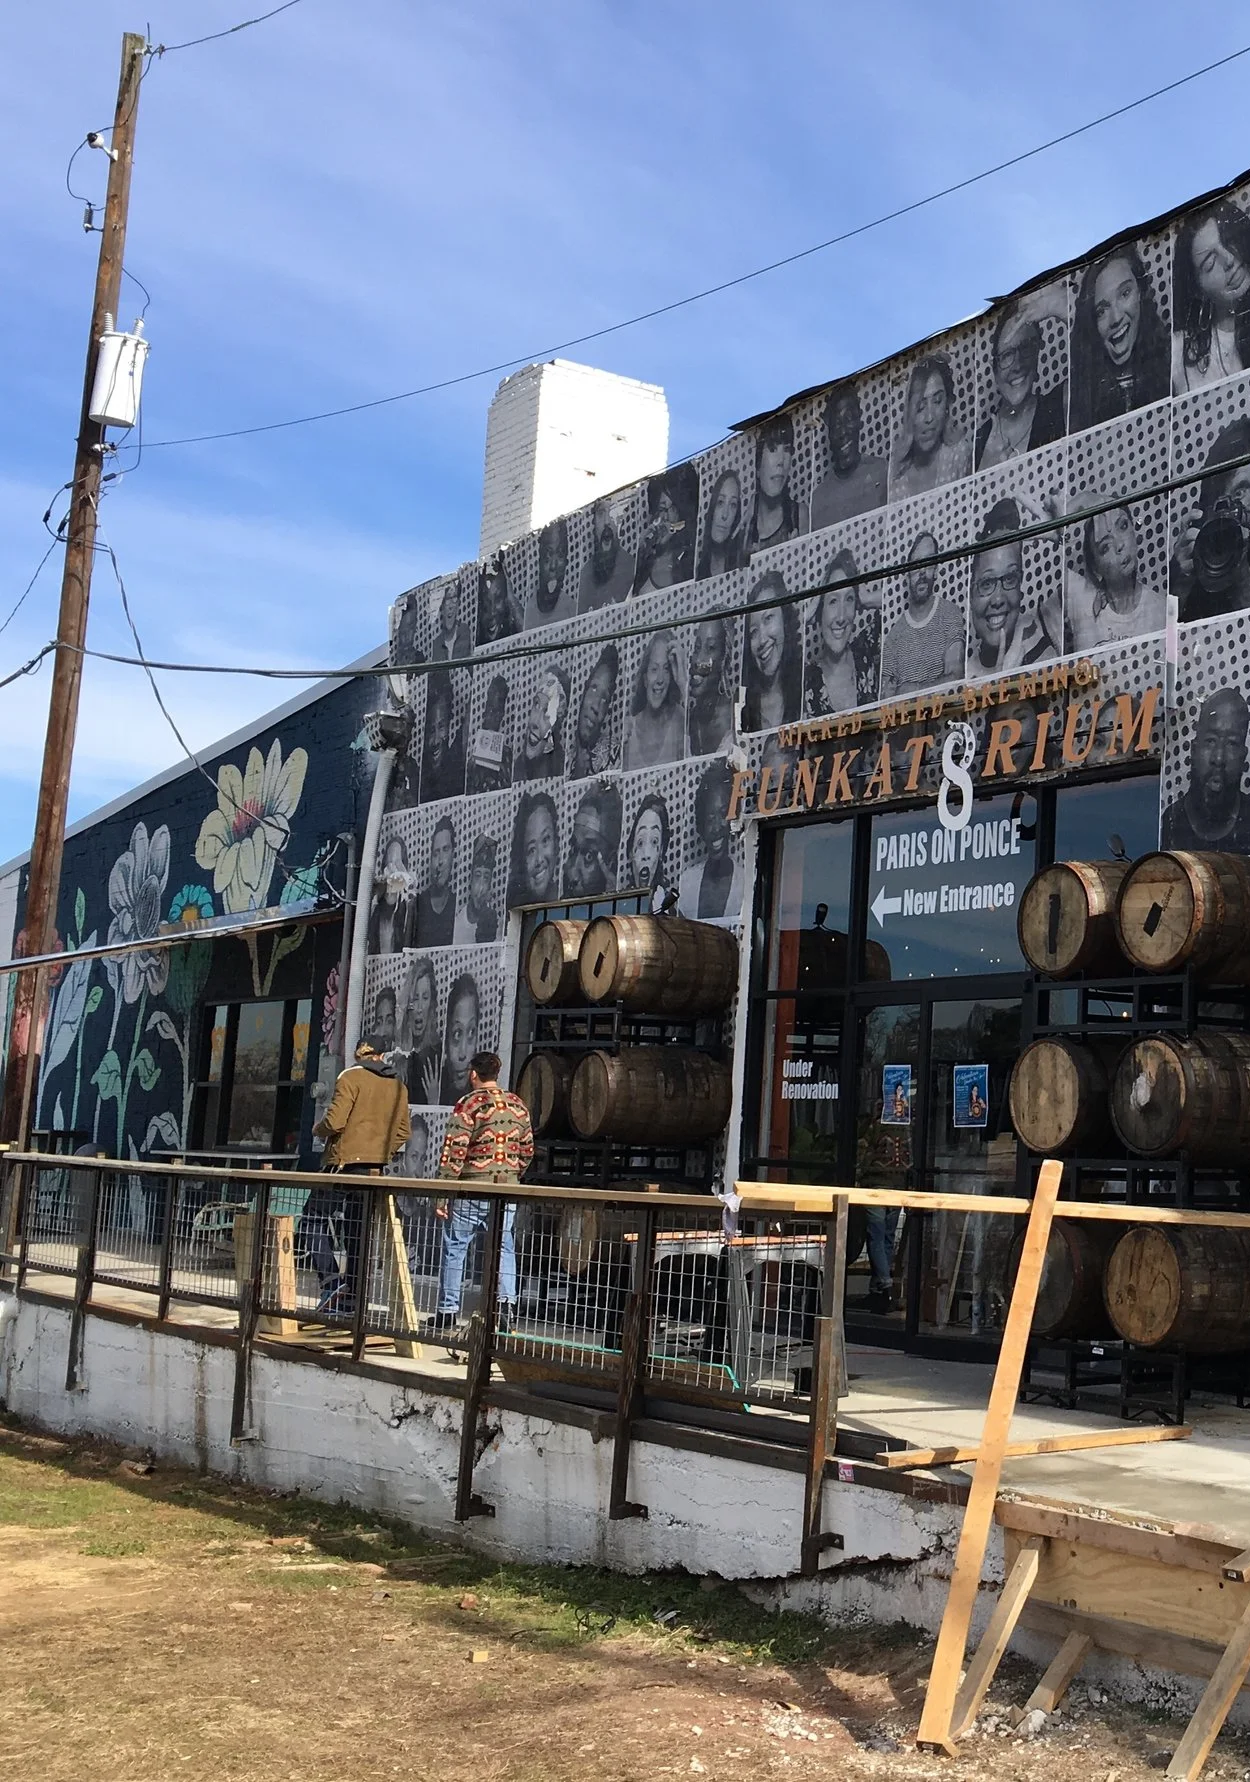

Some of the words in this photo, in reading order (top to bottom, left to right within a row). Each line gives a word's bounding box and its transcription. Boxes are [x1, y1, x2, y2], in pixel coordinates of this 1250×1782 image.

[778, 712, 863, 749] WICKED
[879, 694, 944, 730] WEED
[963, 657, 1093, 713] BREWING
[876, 830, 928, 872] PARIS
[931, 827, 956, 865] ON
[959, 817, 1022, 862] PONCE
[903, 888, 938, 917] New
[939, 881, 1016, 914] Entrance
[782, 1058, 814, 1079] Under
[781, 1079, 840, 1101] Renovation
